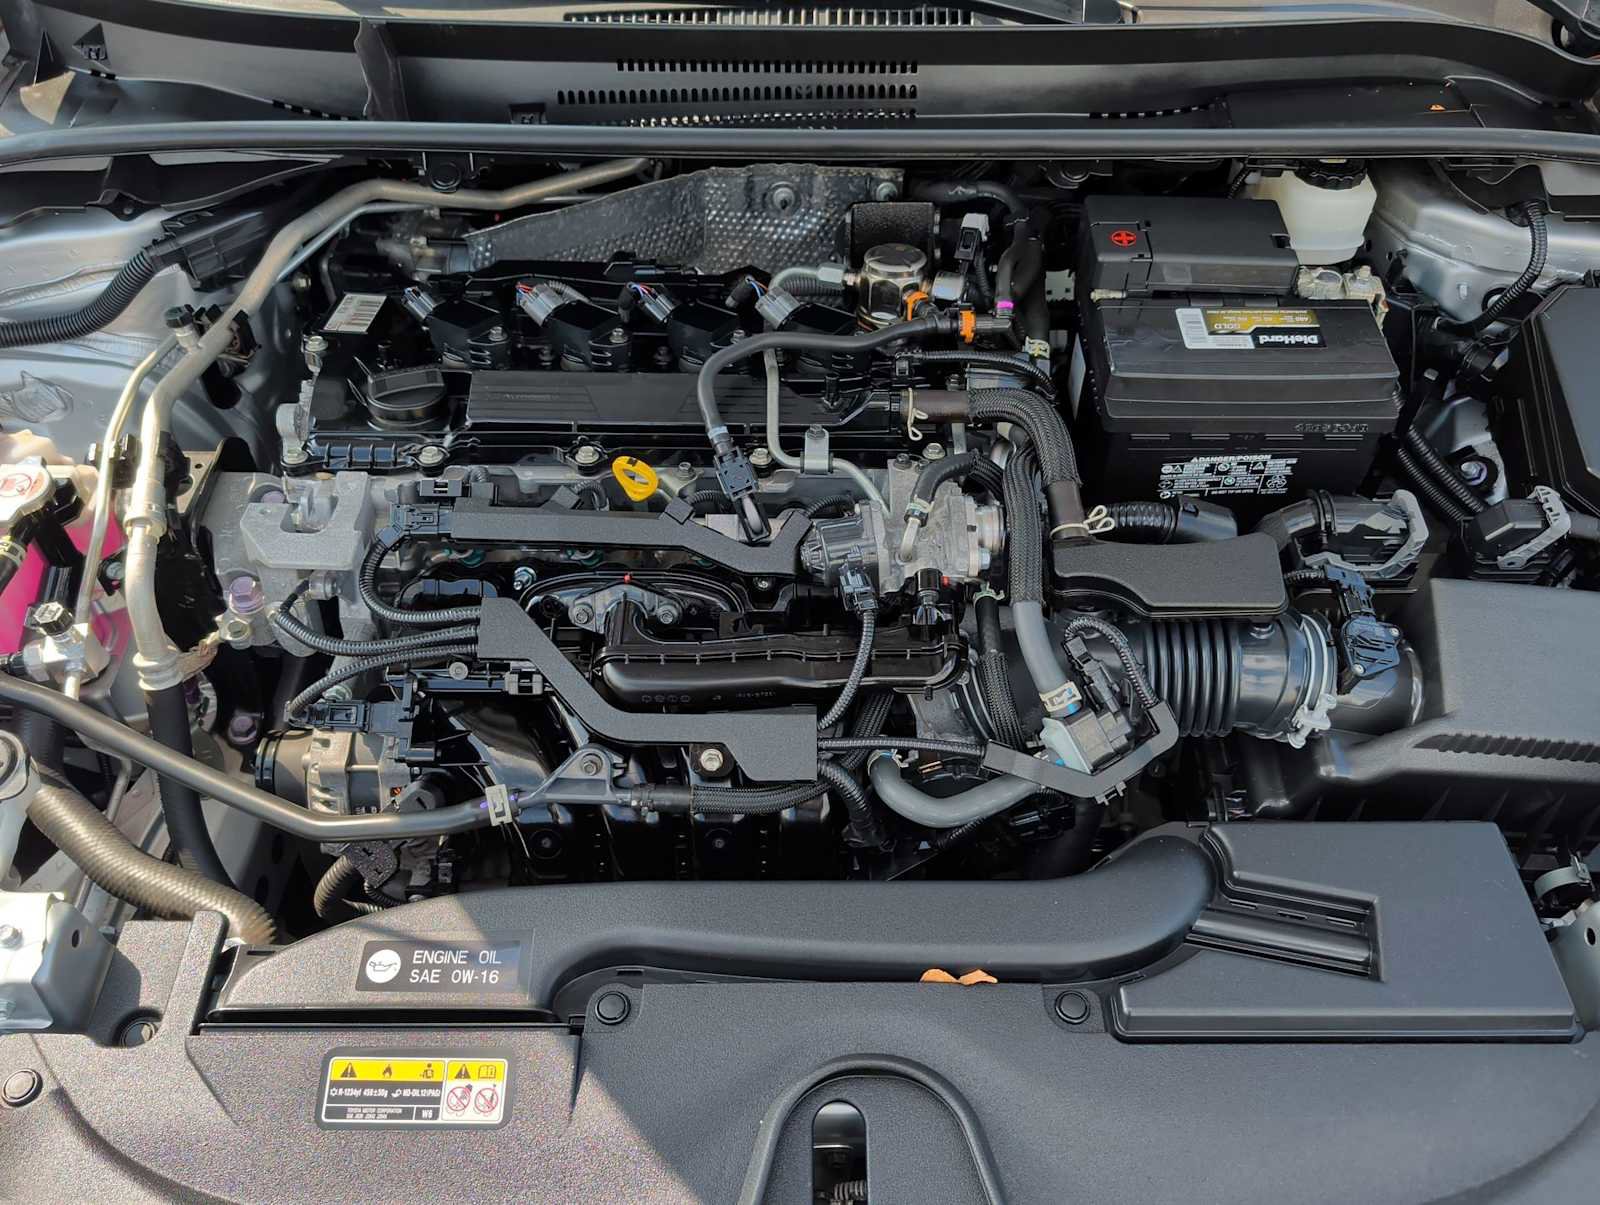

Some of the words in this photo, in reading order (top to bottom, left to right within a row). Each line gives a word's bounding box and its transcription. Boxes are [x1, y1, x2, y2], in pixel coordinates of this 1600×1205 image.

[1258, 334, 1319, 345] DieHard
[412, 950, 469, 965] ENGINE
[478, 950, 502, 964] OIL
[409, 969, 442, 983] SAE
